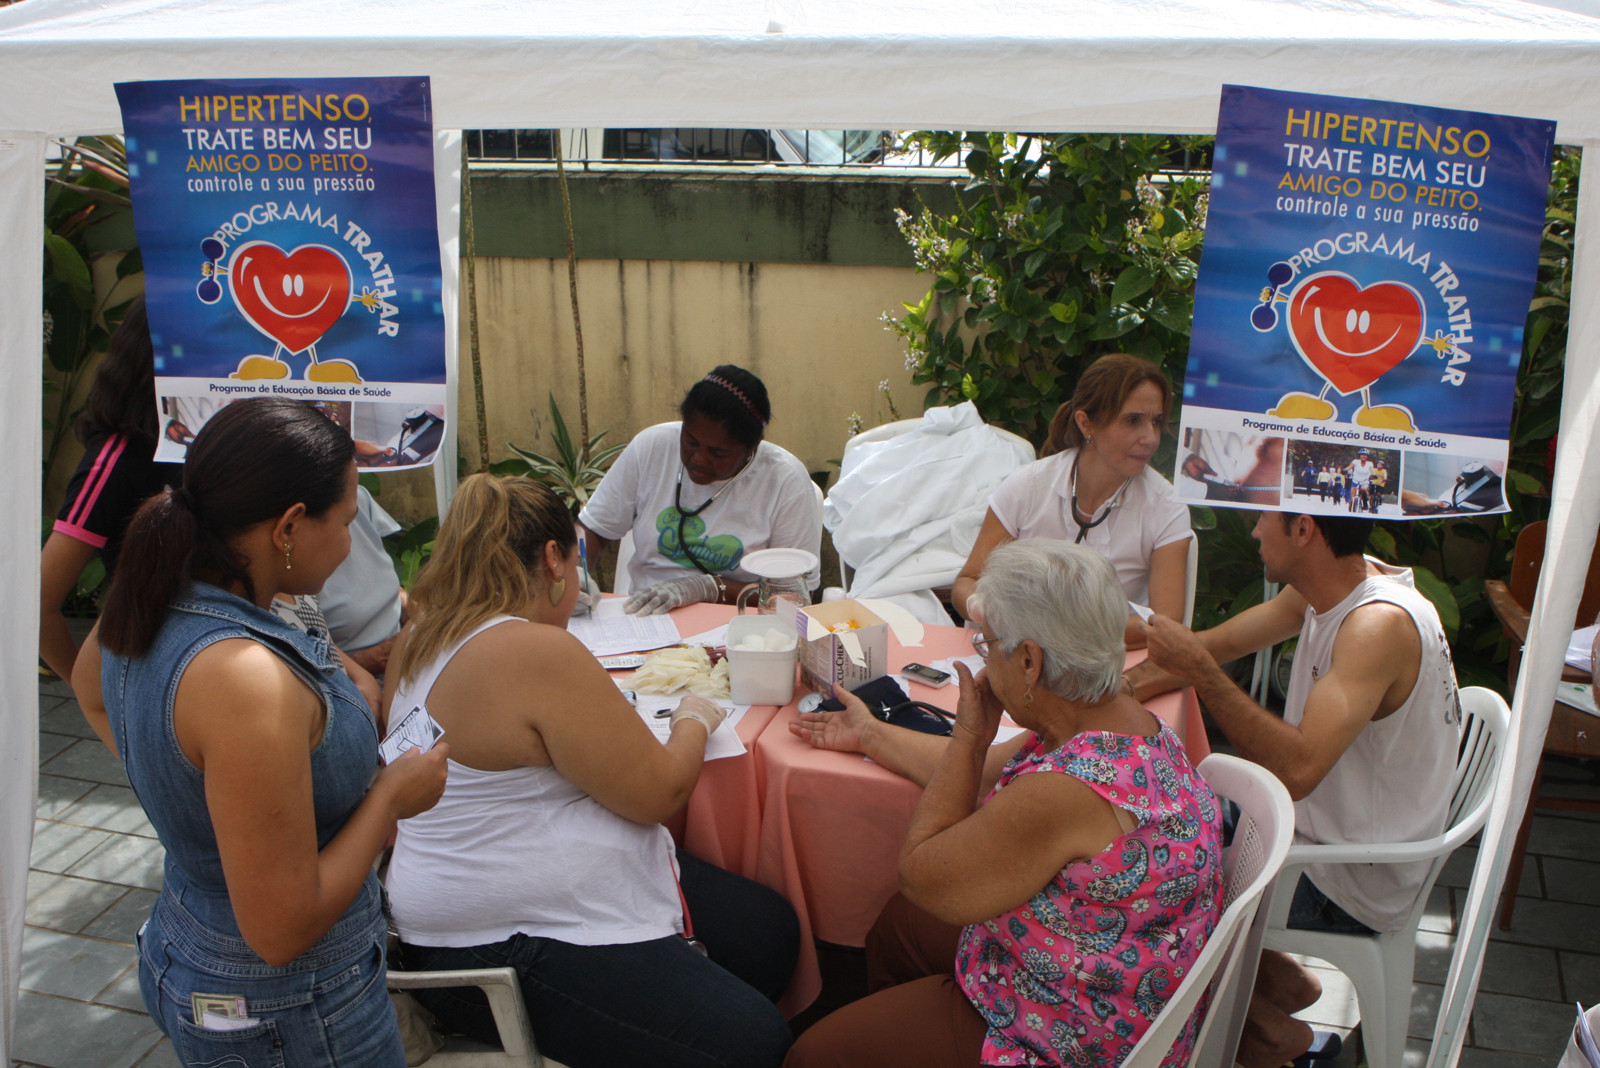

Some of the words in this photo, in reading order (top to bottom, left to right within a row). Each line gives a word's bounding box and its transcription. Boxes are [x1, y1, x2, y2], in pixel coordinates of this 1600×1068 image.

[179, 94, 373, 123] HIPERTENSO,
[182, 128, 254, 151] TRATE
[263, 127, 315, 150] BEM
[324, 127, 372, 150] SEU
[1285, 108, 1491, 162] HIPERTENSO,
[185, 154, 260, 173] AMIGO
[267, 154, 303, 172] DO
[310, 153, 374, 172] PEITO.
[1284, 143, 1363, 174] TRATE
[1371, 153, 1426, 181] BEM
[1435, 161, 1486, 188] SEU
[188, 172, 253, 192] controle
[261, 177, 270, 191] a
[278, 177, 305, 191] sua
[314, 173, 375, 195] pressão
[1277, 171, 1362, 197] AMIGO
[1370, 180, 1407, 202] DO
[1415, 185, 1483, 212] PEITO.
[1276, 195, 1348, 218] controle
[1356, 205, 1366, 219] a
[1374, 206, 1403, 224] sua
[1412, 210, 1480, 232] pressão
[214, 200, 339, 249] PROGRAMA
[342, 220, 399, 337] TRATHAR
[1289, 231, 1432, 275] PROGRAMA
[1429, 261, 1474, 387] TRATHAR
[209, 384, 256, 396] Programa
[258, 385, 270, 394] de
[272, 385, 314, 396] Educação
[317, 385, 347, 396] Básica
[349, 386, 361, 396] de
[363, 386, 391, 397] Saúde
[1242, 419, 1293, 433] Programa
[1296, 424, 1310, 434] de
[1312, 425, 1360, 441] Educação
[1363, 430, 1396, 444] Básica
[1398, 435, 1412, 446] de
[1414, 437, 1447, 449] Saúde
[835, 643, 844, 689] CCU-CHEK
